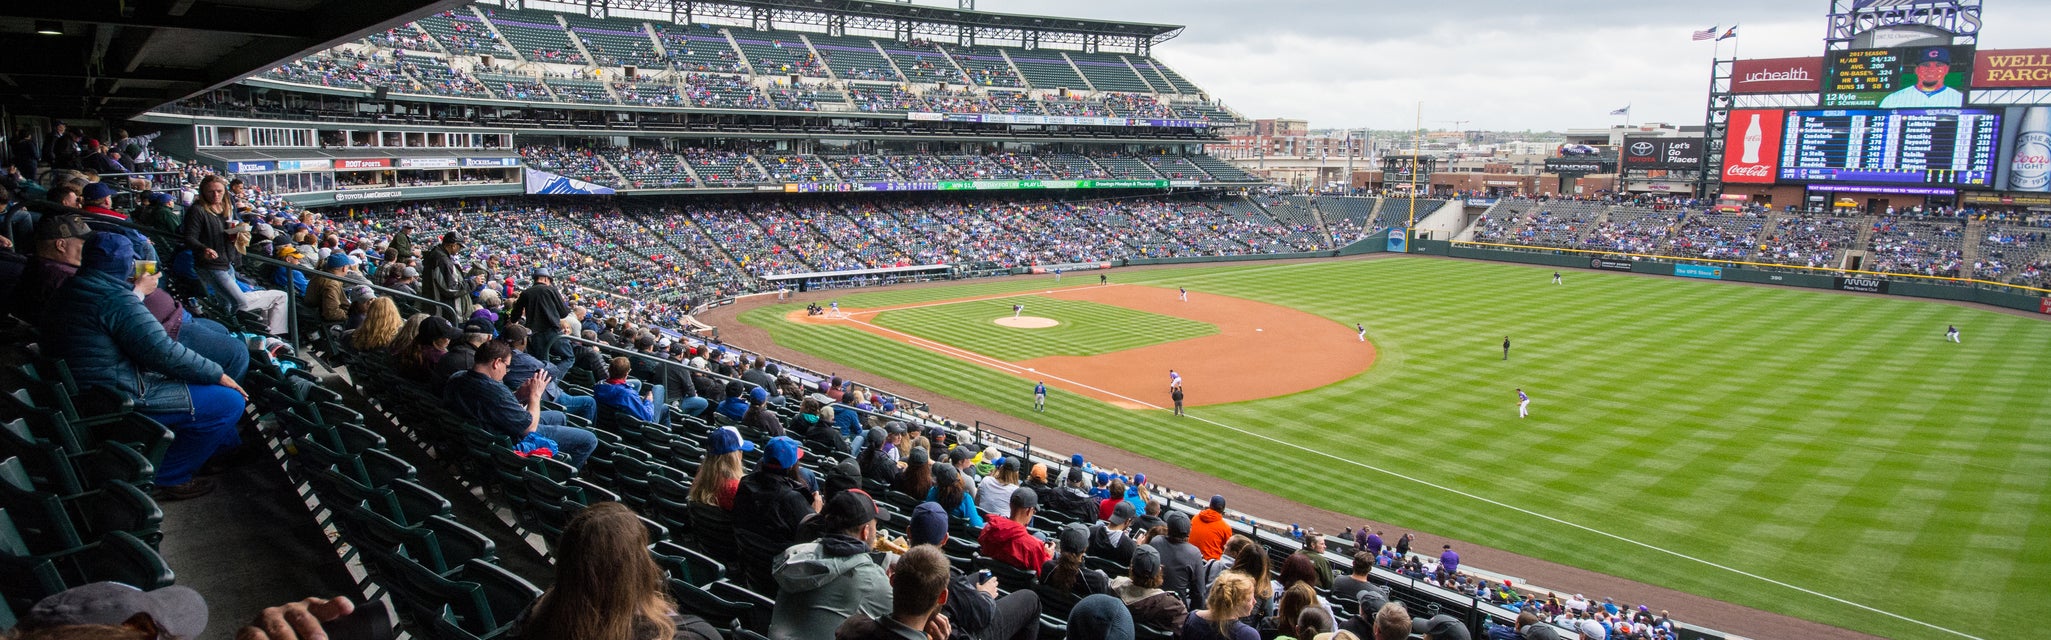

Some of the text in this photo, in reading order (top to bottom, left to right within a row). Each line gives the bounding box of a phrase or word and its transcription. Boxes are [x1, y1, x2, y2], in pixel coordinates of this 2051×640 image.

[1823, 6, 1982, 40] ROCKIES
[1746, 67, 1808, 80] uchealth
[1838, 93, 1856, 101] Kyle
[2013, 151, 2050, 164] Coors
[1726, 164, 1772, 177] Coca-Cola
[1844, 278, 1879, 287] ARROW
